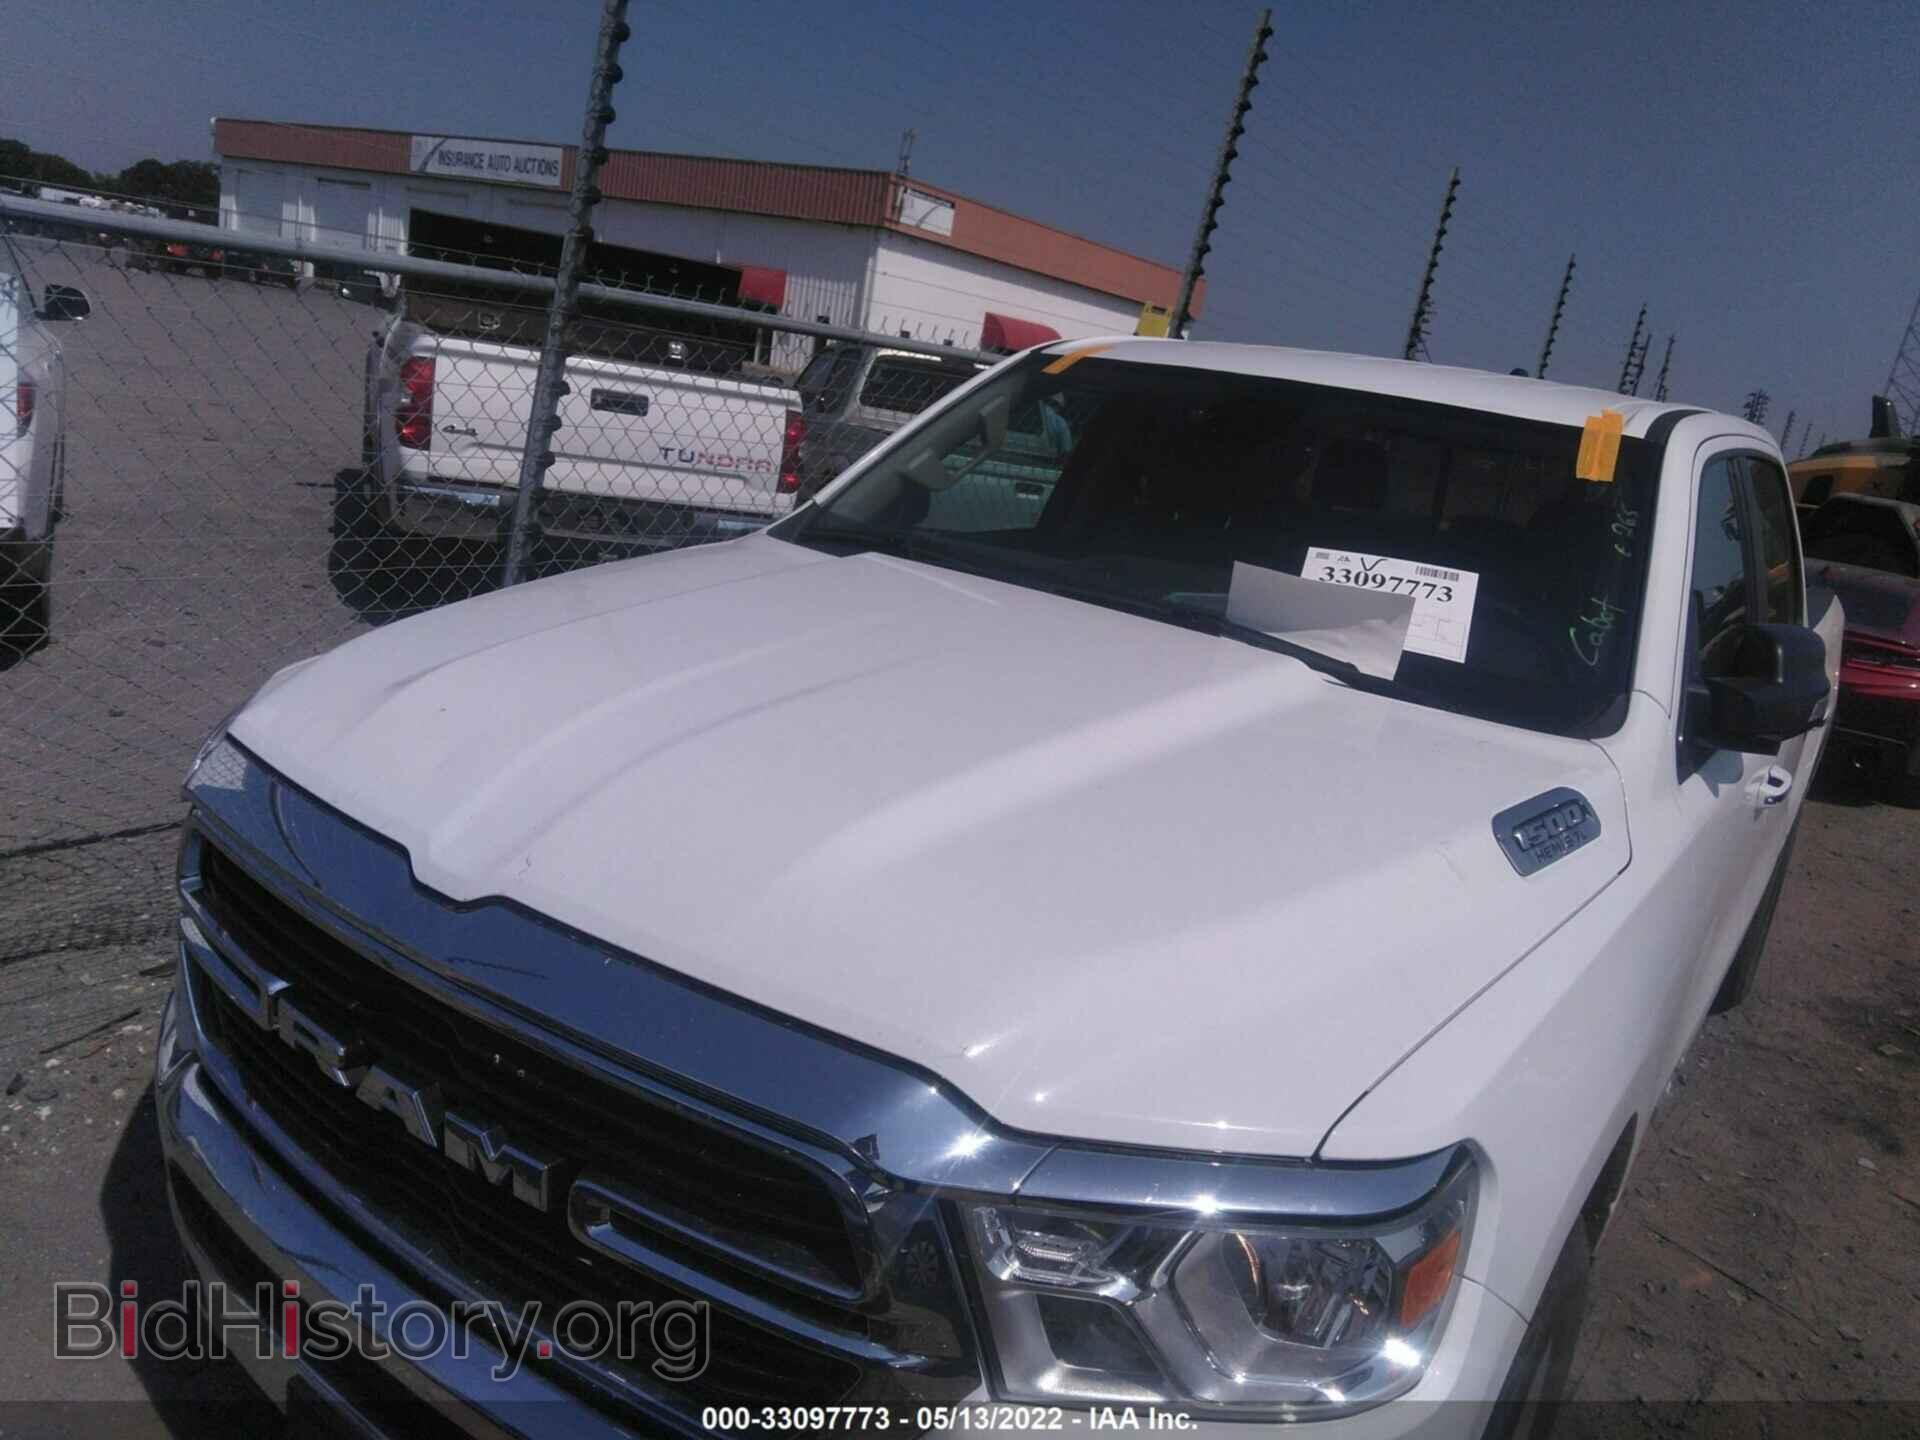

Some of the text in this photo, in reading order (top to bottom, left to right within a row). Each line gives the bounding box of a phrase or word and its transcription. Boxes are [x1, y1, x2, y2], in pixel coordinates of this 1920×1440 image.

[438, 150, 560, 177] INSURANCE AUTO AUCTIONS
[659, 447, 772, 472] TUNDRA
[1319, 566, 1453, 603] 33097773
[1513, 801, 1585, 851] 1500
[279, 997, 550, 1213] RAM
